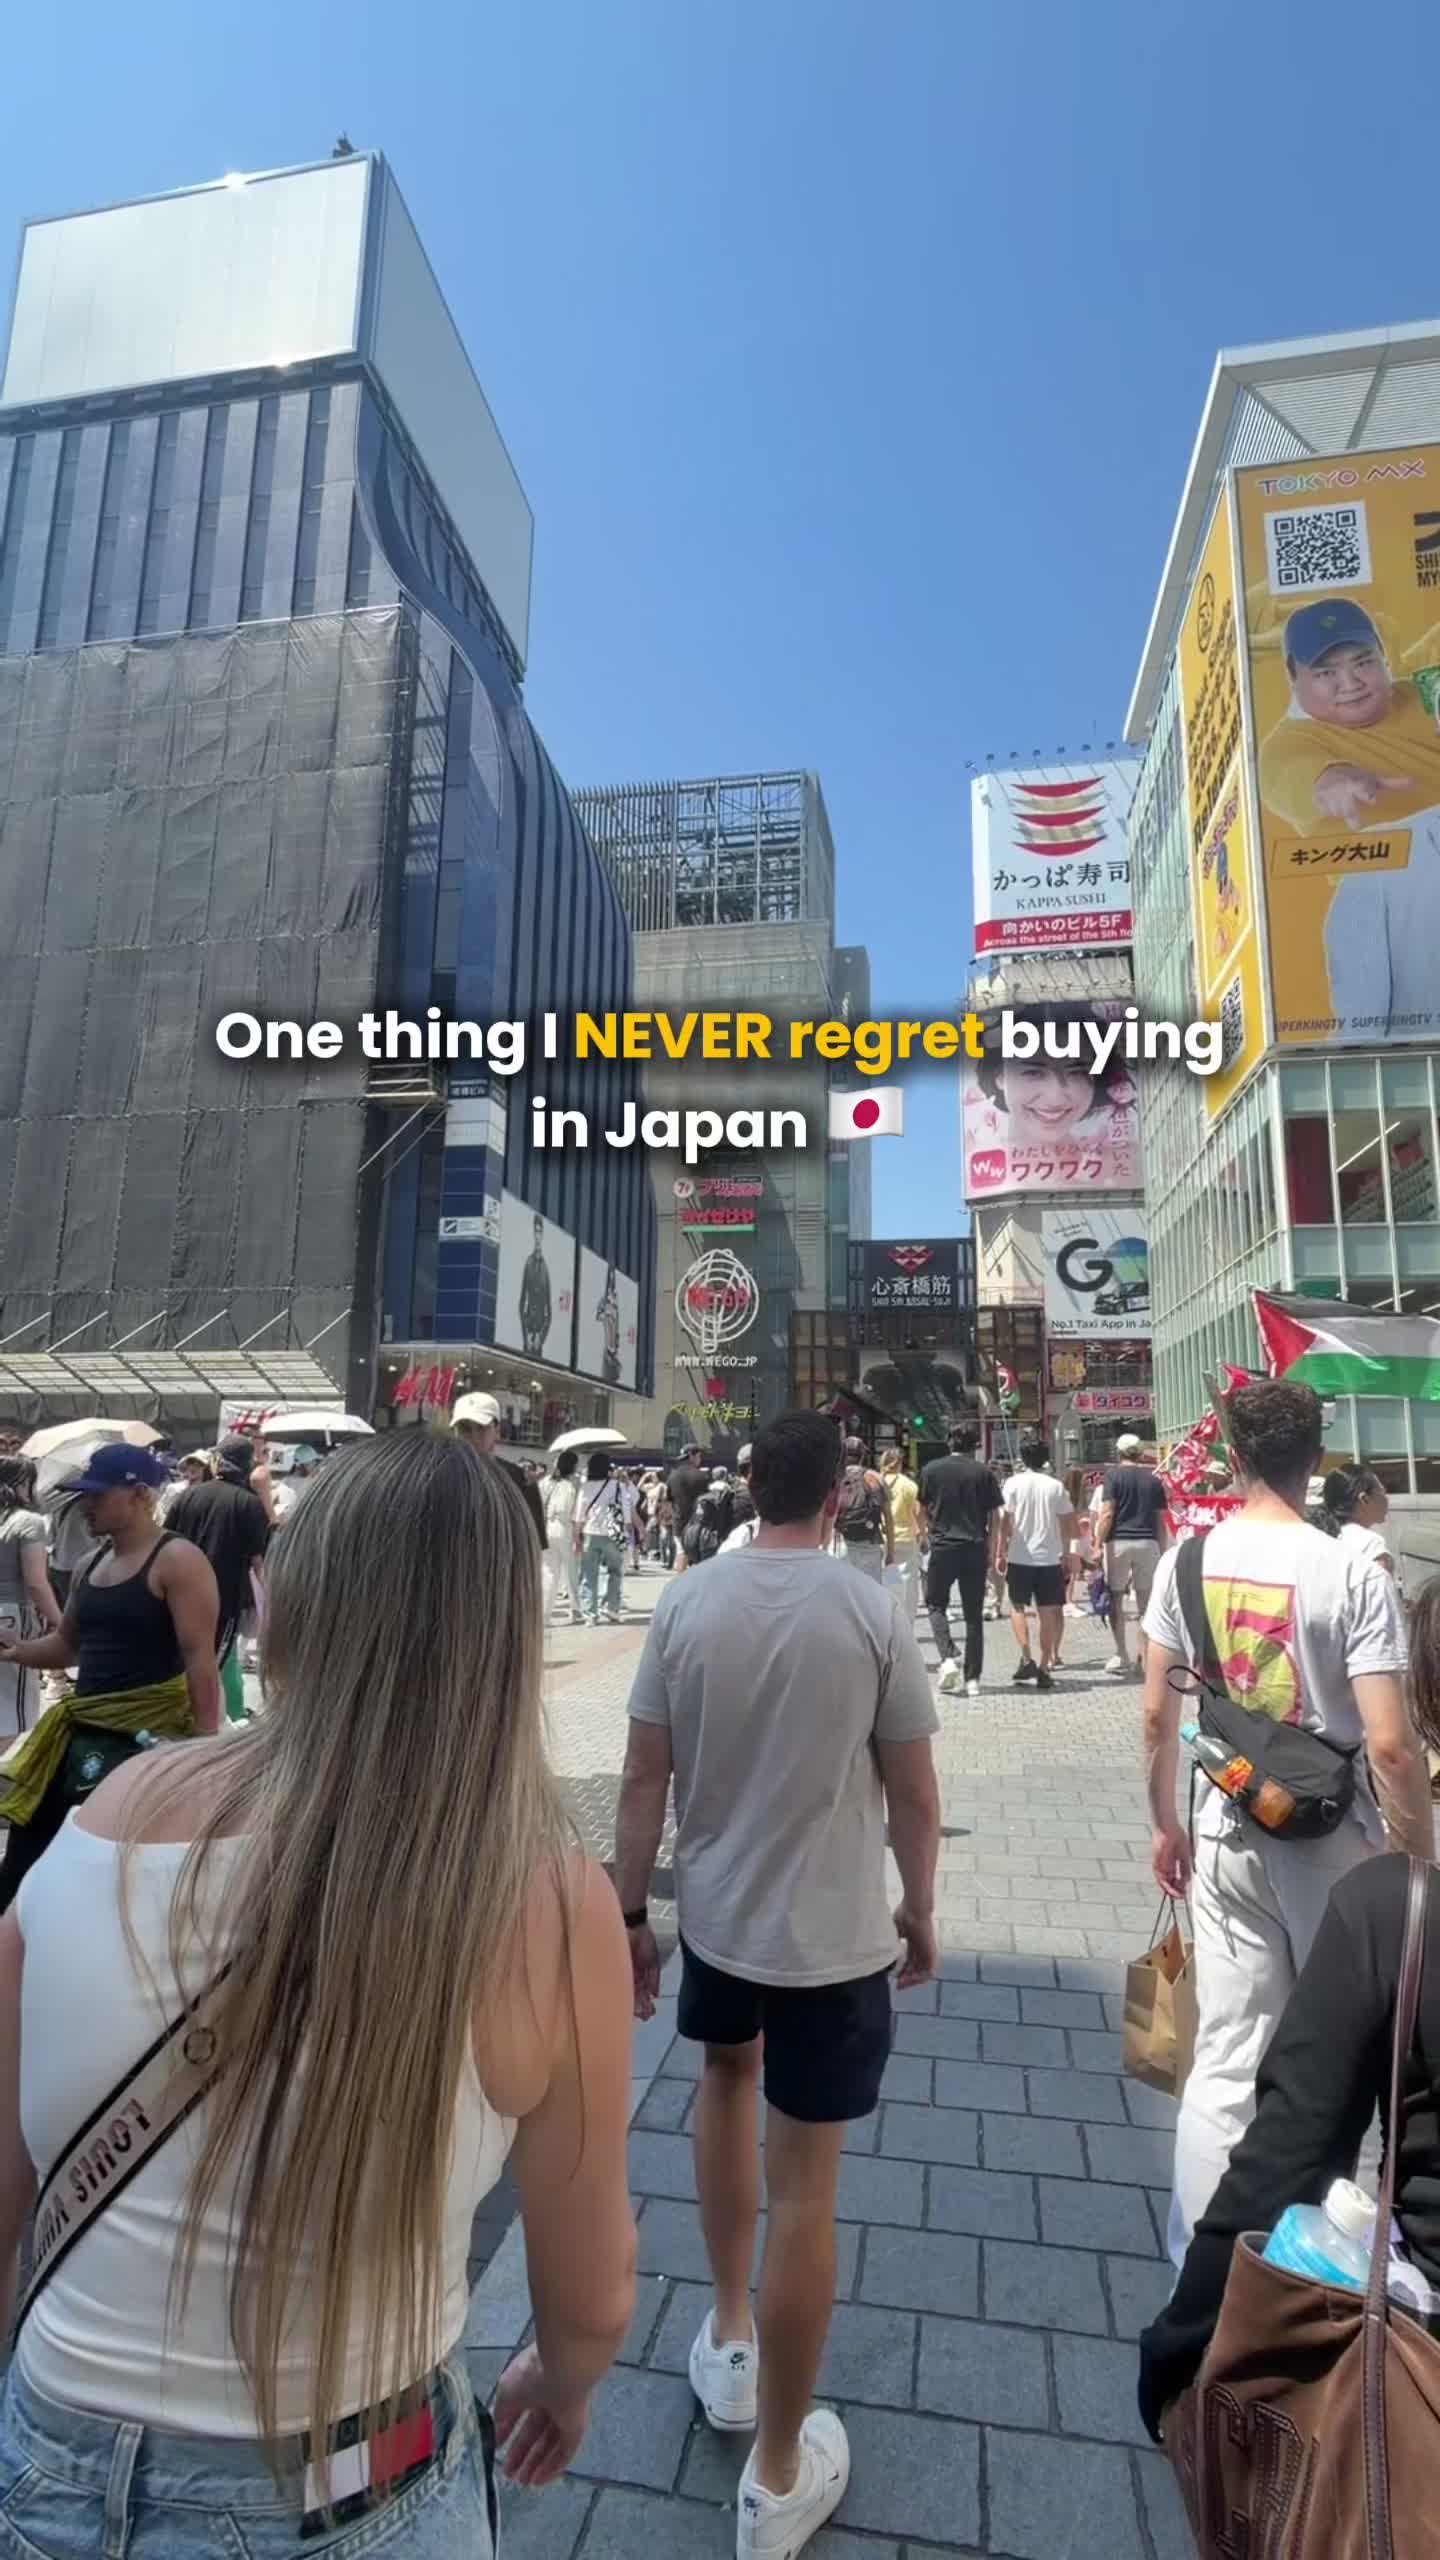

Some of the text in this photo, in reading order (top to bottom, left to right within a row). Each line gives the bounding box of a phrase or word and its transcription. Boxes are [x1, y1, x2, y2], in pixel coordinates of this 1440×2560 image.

[1257, 458, 1426, 496] TOKYO MX
[1290, 842, 1391, 866] キング大山
[993, 860, 1131, 891] かっぱ寿司
[1016, 892, 1106, 910] KAPPA SUSHI
[1002, 914, 1122, 936] 向かいのビル5F
[983, 935, 1017, 948] Across
[1020, 933, 1036, 945] the
[1038, 932, 1067, 943] street
[1069, 931, 1080, 942] of
[1082, 929, 1099, 941] the
[1011, 1160, 1103, 1182] ワクワク
[872, 1275, 952, 1296] 心斎橋筋
[1051, 1320, 1073, 1329] No.1
[1077, 1319, 1098, 1329] Taxi
[1101, 1319, 1124, 1329] App
[1126, 1319, 1136, 1329] in
[674, 1355, 758, 1367] WWW.WEGO.JP
